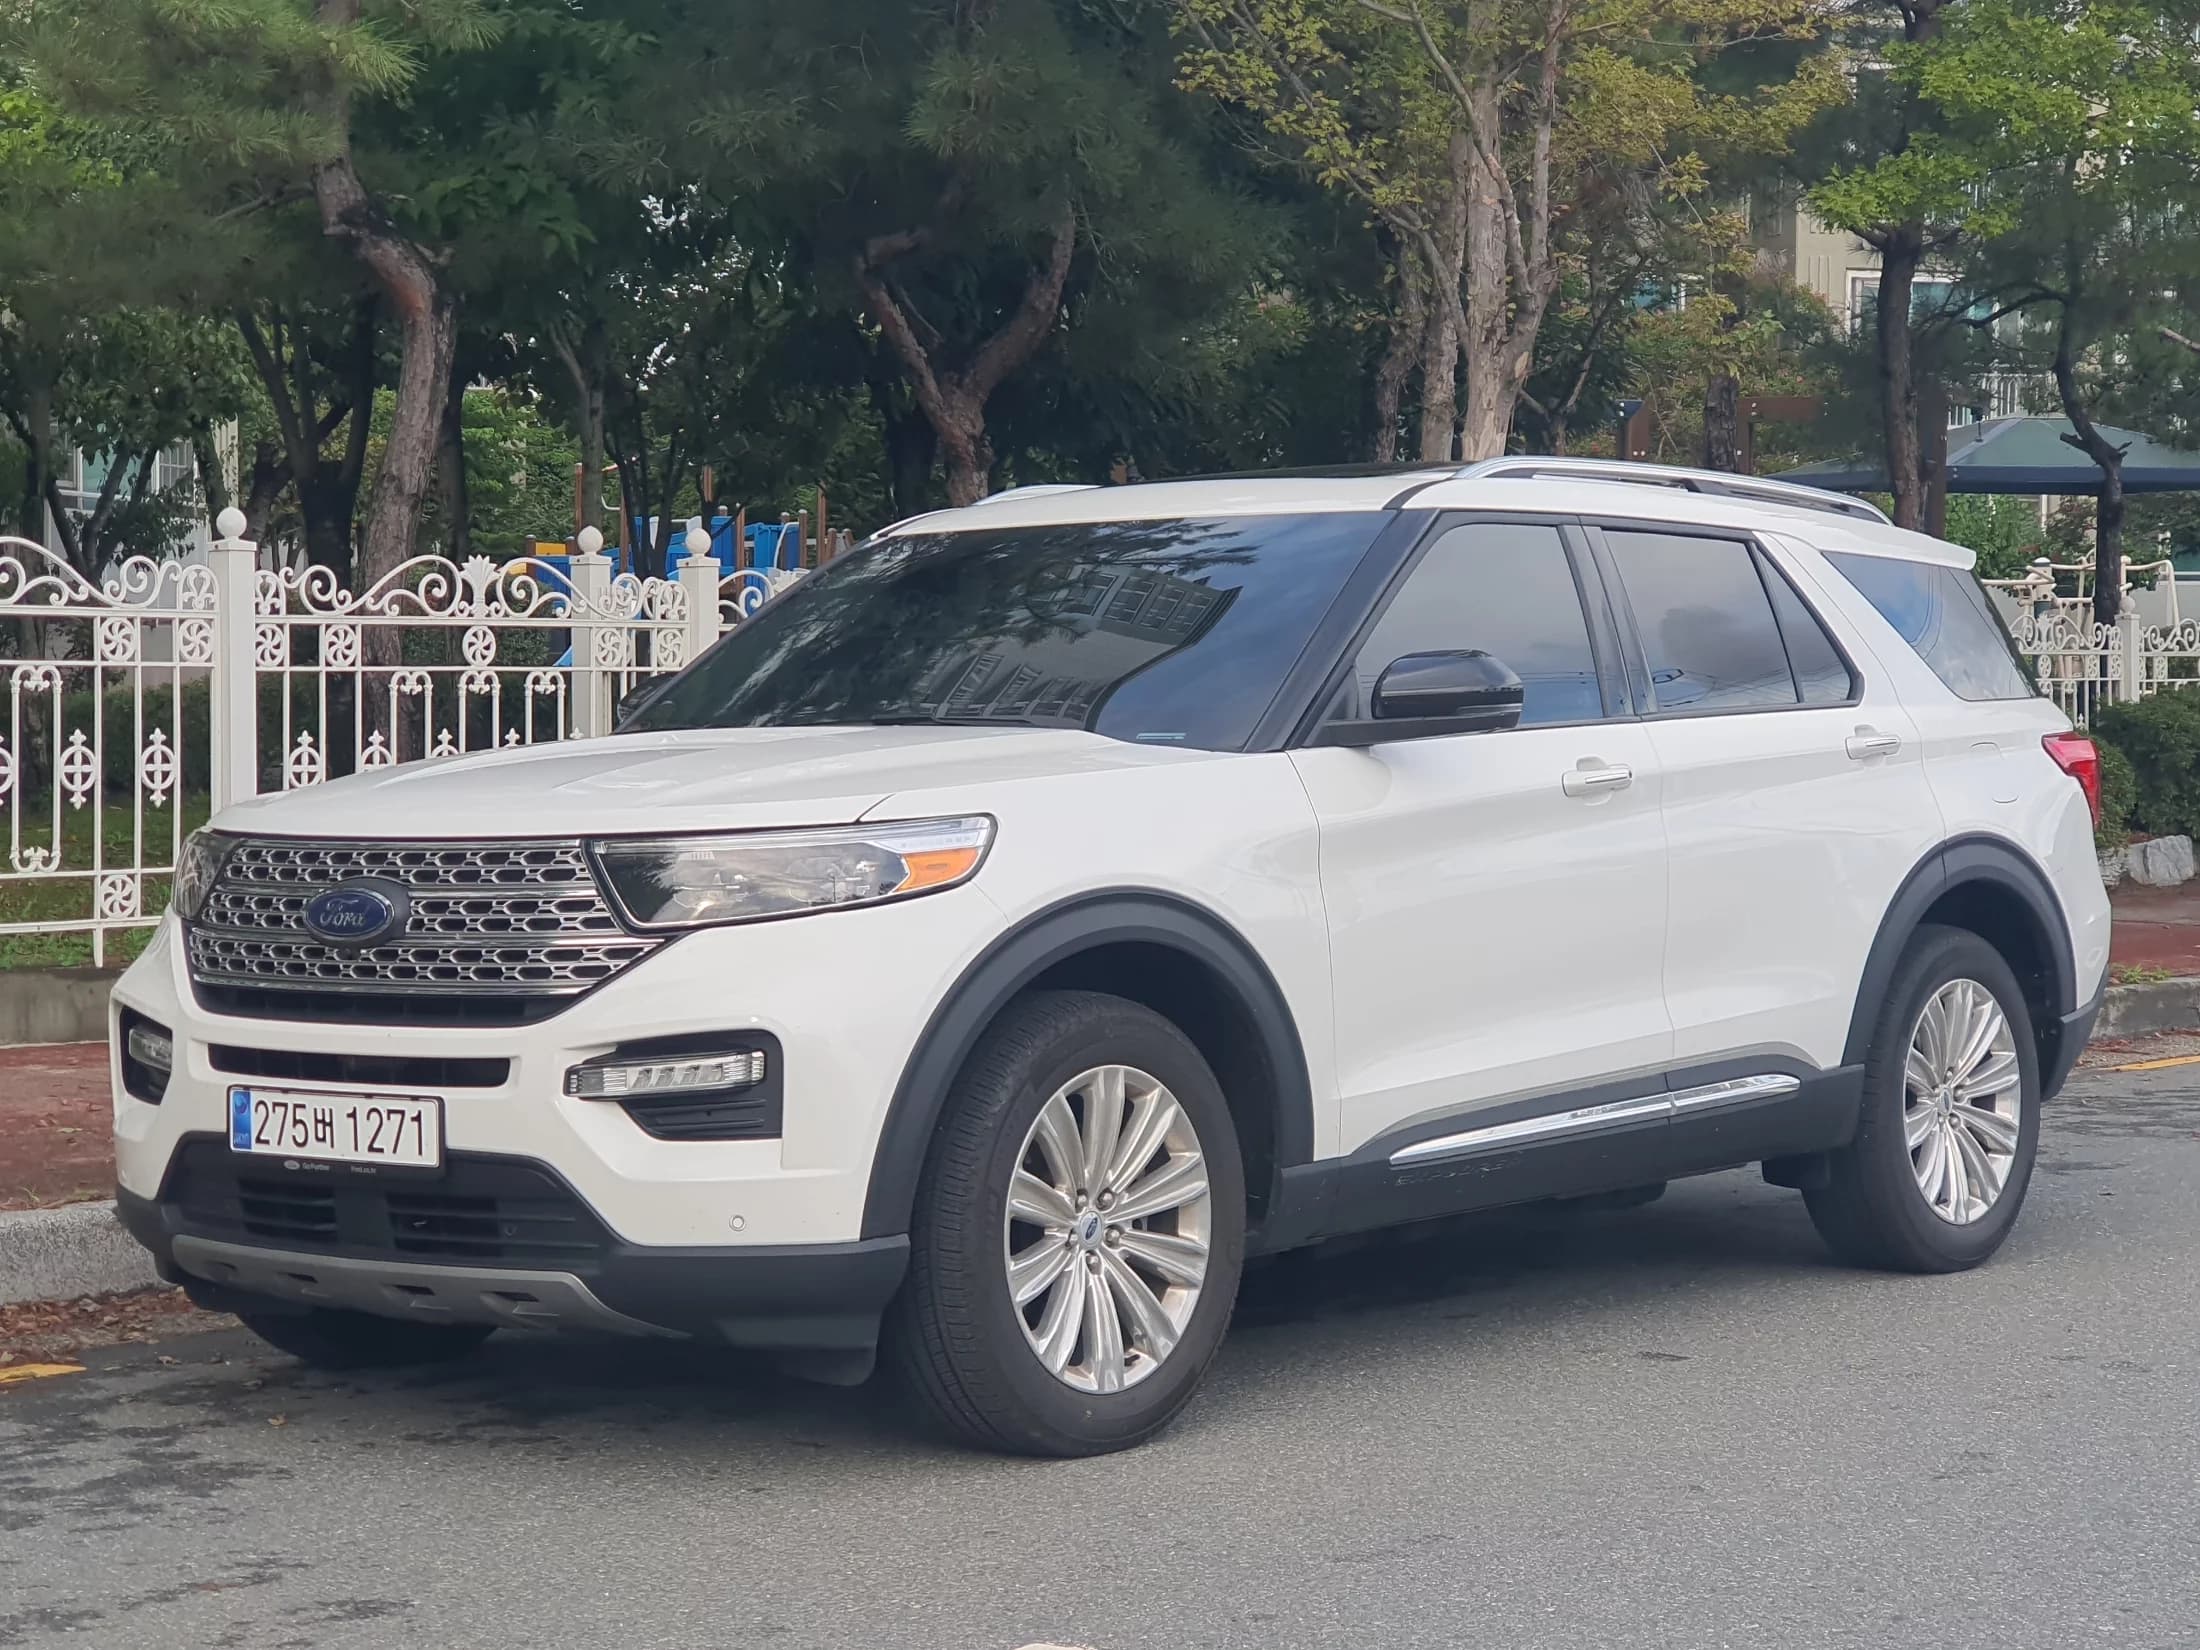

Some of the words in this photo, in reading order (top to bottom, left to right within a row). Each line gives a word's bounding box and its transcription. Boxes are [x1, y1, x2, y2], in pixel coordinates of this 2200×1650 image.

[320, 899, 372, 927] Ford
[254, 1099, 334, 1149] 275버
[346, 1106, 423, 1156] 1271
